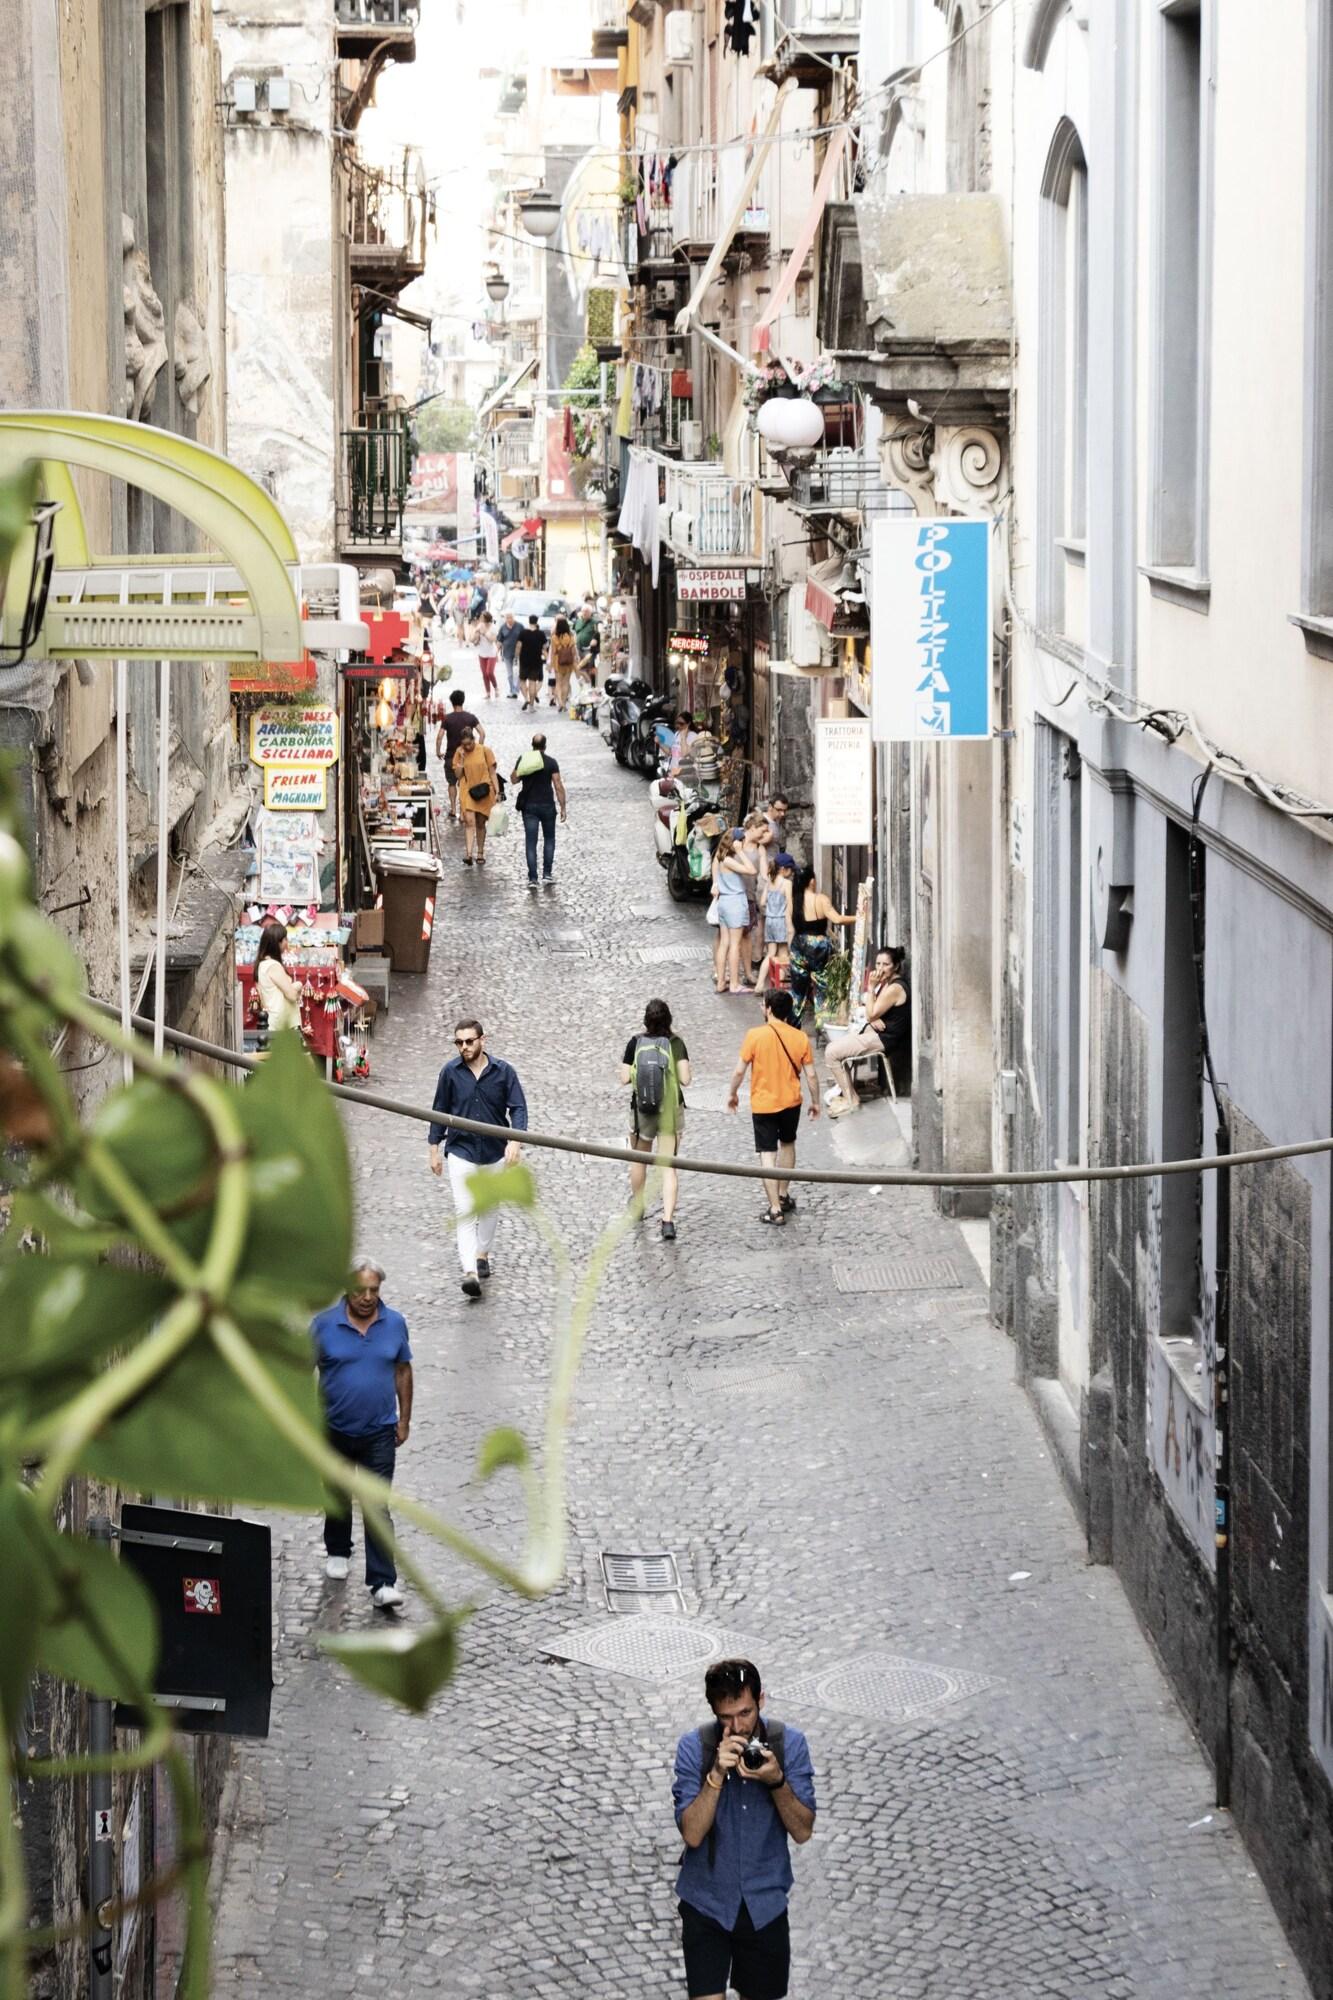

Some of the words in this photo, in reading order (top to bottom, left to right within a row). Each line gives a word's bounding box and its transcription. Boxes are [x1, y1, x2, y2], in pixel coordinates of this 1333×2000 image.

[689, 570, 745, 581] OSPEDALE
[681, 587, 745, 599] BAMBOLE
[914, 526, 952, 692] POLIZIA
[670, 637, 709, 651] MERCERIA
[824, 727, 864, 736] TRATTORIA
[259, 736, 334, 747] CARBONARA
[262, 749, 334, 759] SICILIANA
